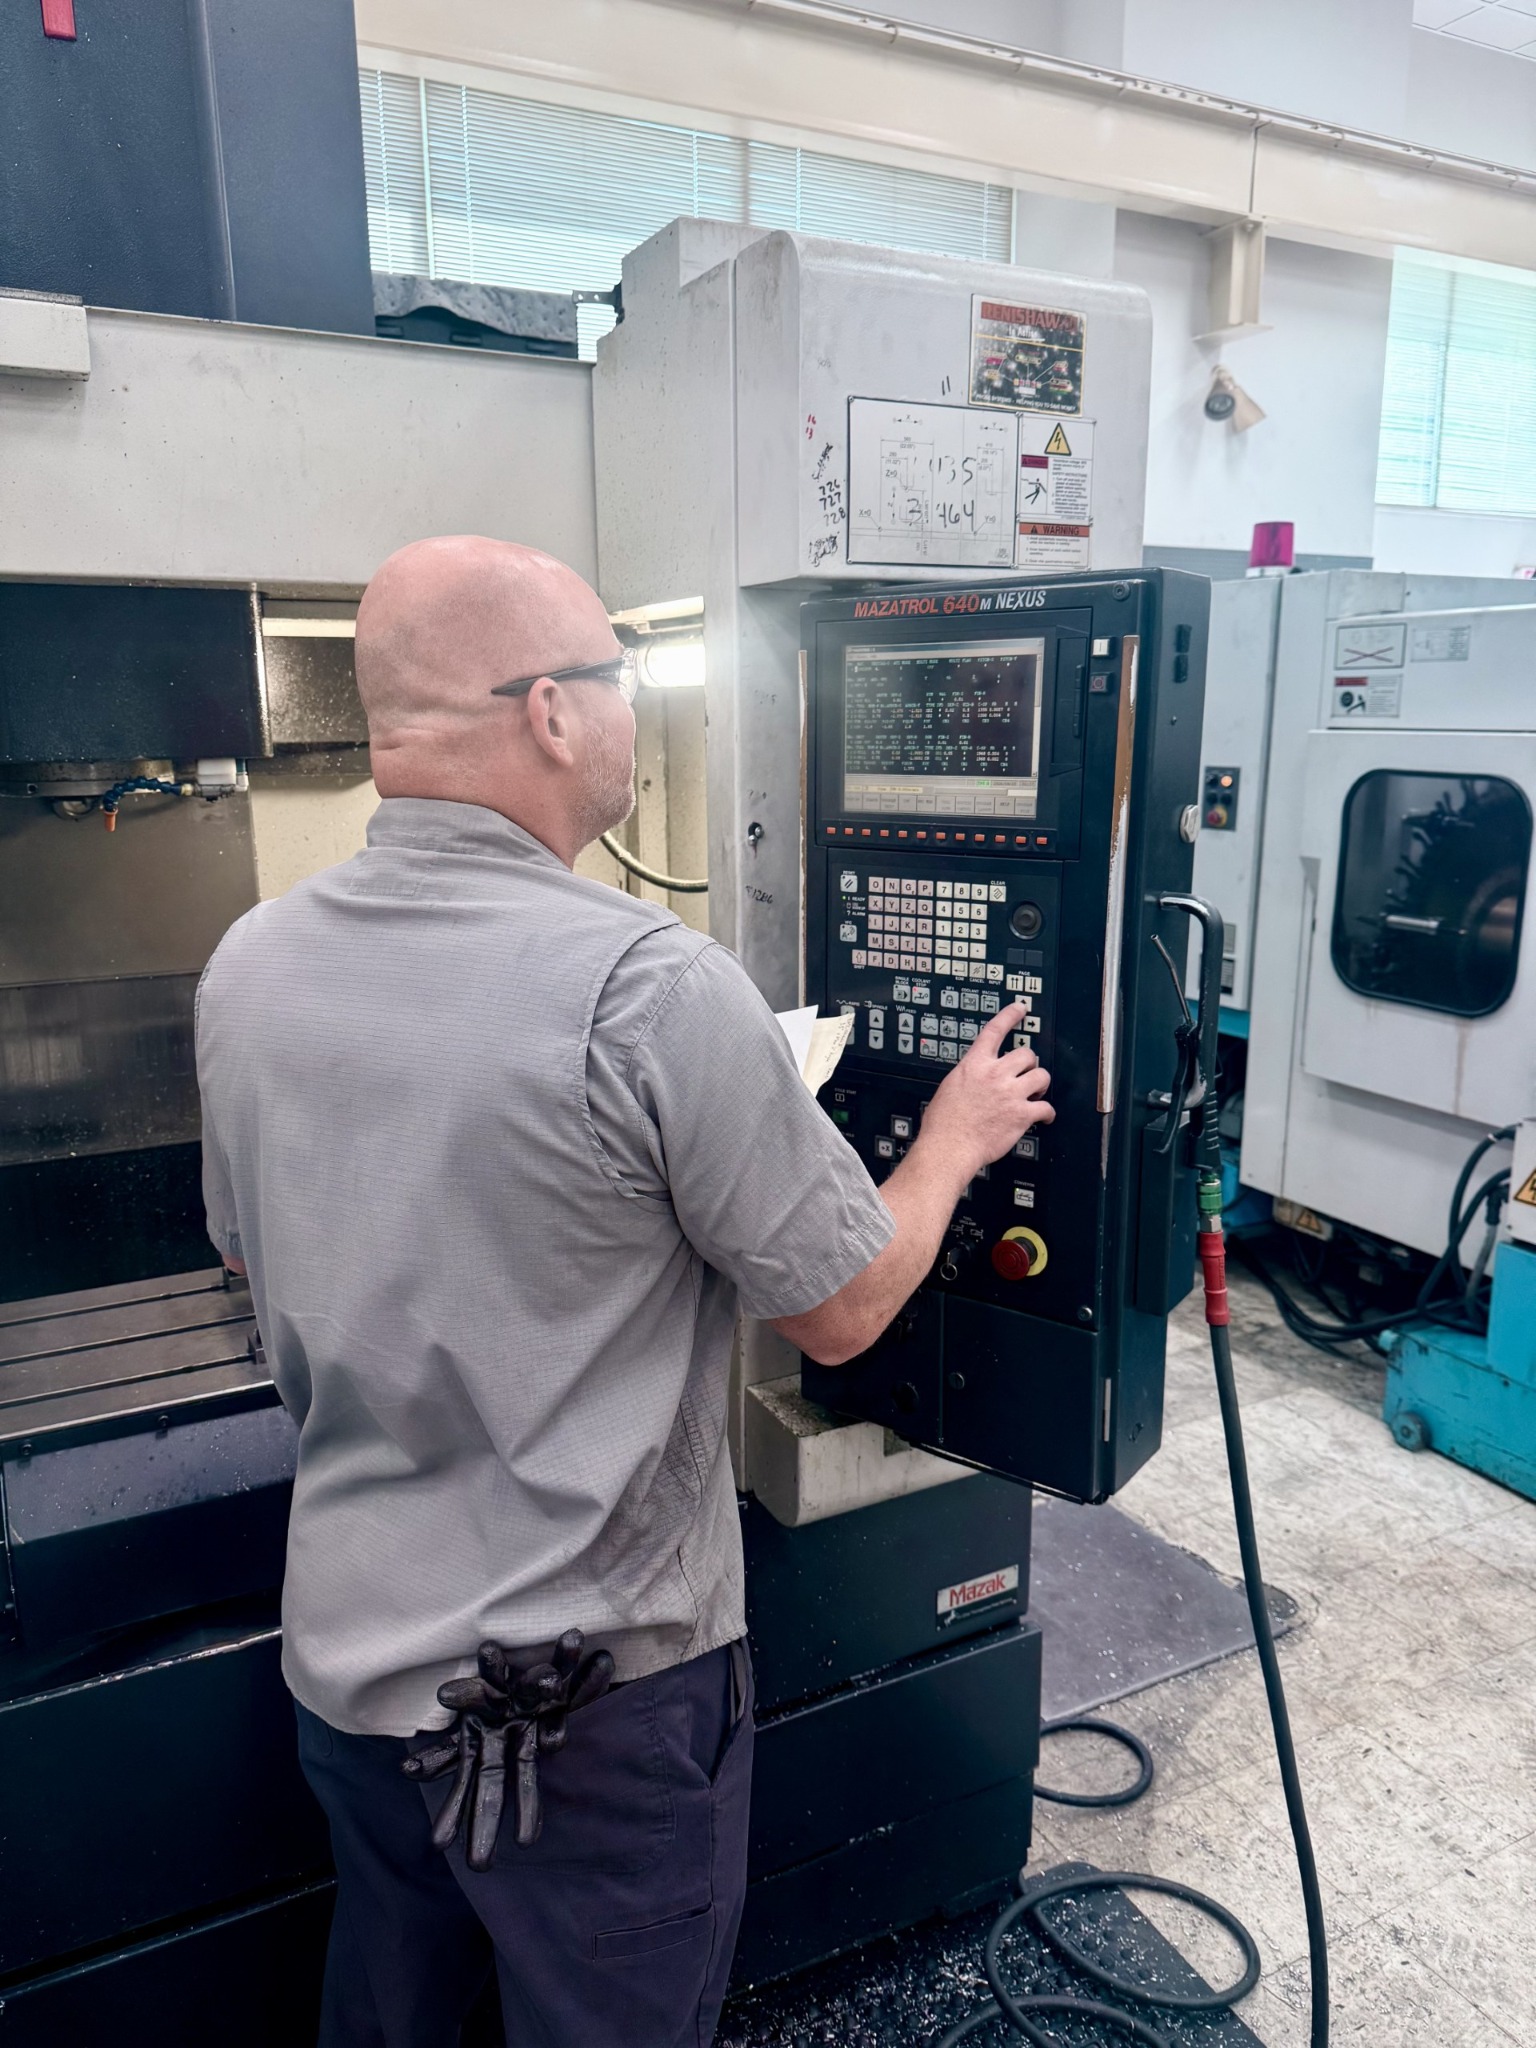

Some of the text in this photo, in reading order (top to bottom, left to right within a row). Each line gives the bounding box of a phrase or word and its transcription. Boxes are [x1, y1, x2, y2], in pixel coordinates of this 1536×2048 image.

[1043, 525, 1079, 536] WARNING
[854, 598, 938, 618] MAZATROL
[995, 590, 1046, 610] NEXUS
[949, 1574, 1006, 1607] Mazak
